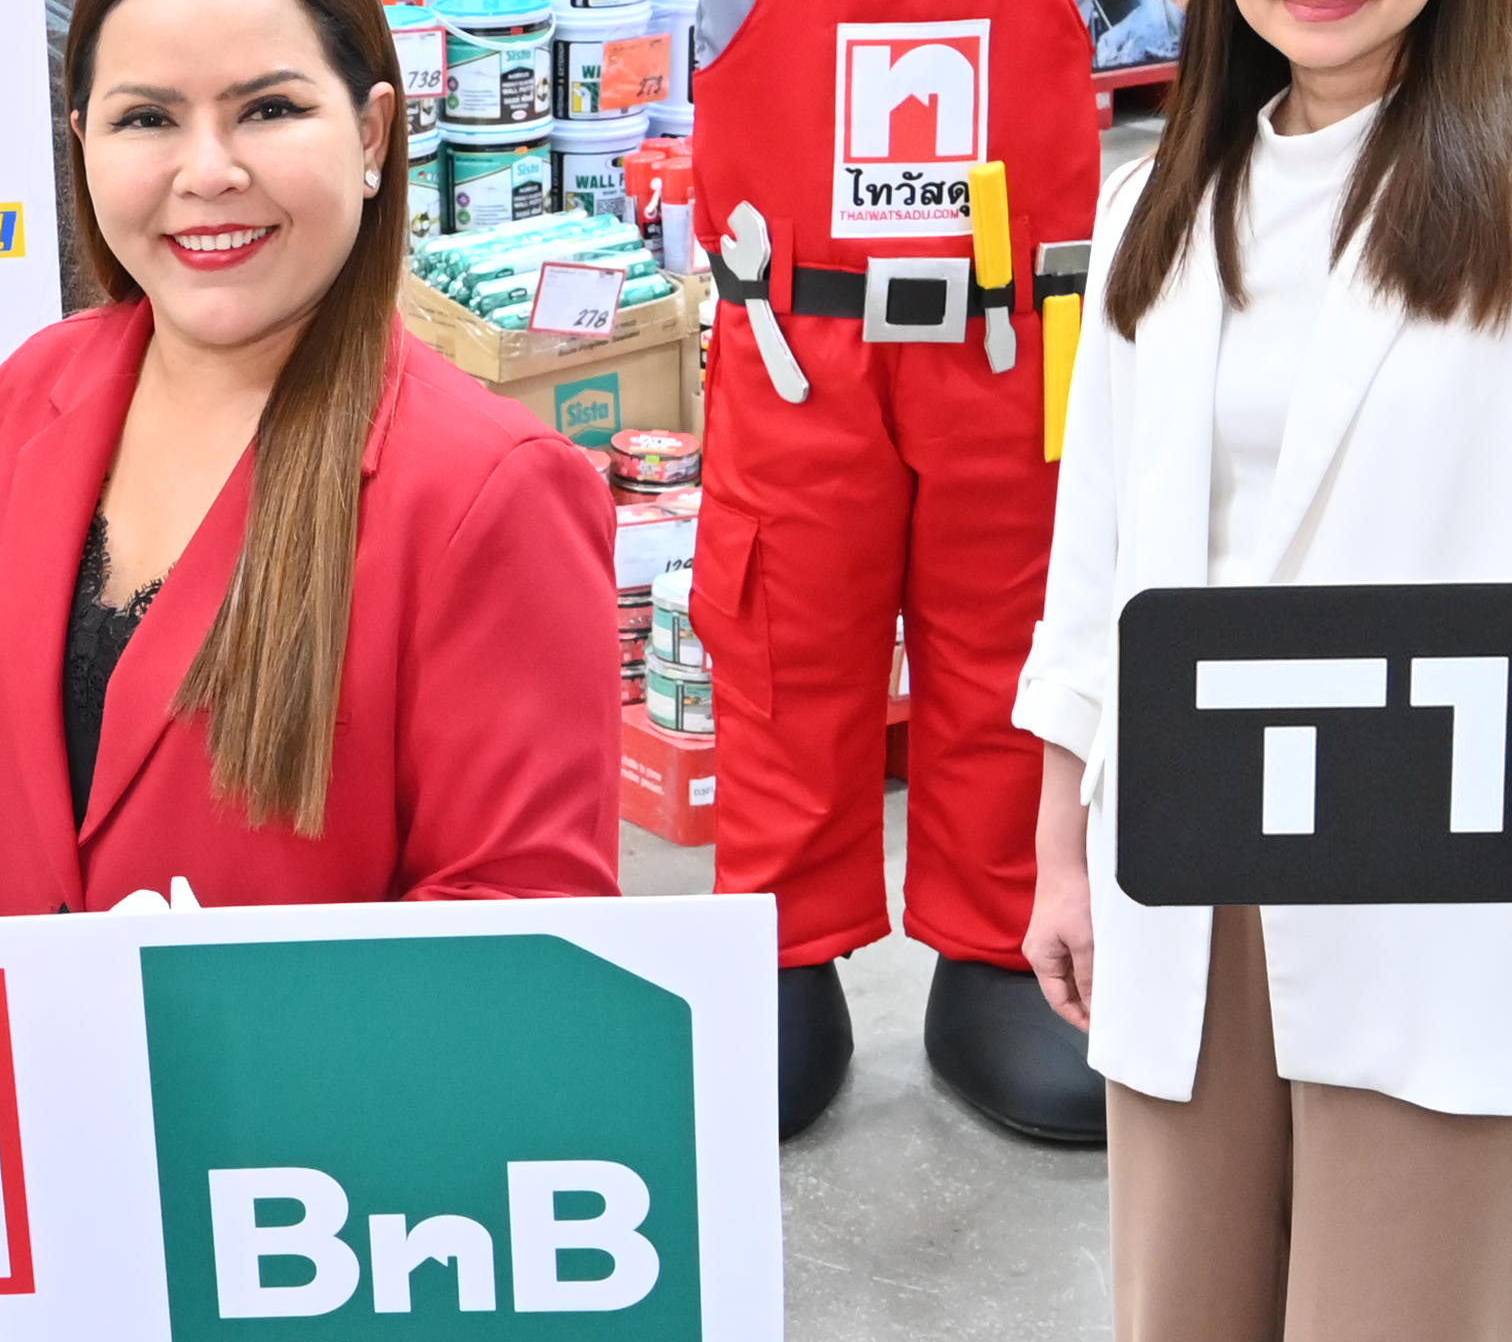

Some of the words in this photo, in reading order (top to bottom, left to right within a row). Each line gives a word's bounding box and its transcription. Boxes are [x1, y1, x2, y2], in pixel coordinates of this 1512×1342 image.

[406, 69, 442, 90] 738
[575, 174, 616, 190] WALL
[845, 166, 971, 216] ไทวัสดุ
[837, 207, 963, 222] THAIWATSADU.COM
[573, 308, 610, 329] 278
[566, 399, 610, 427] Sista
[208, 1159, 660, 1320] BnB
